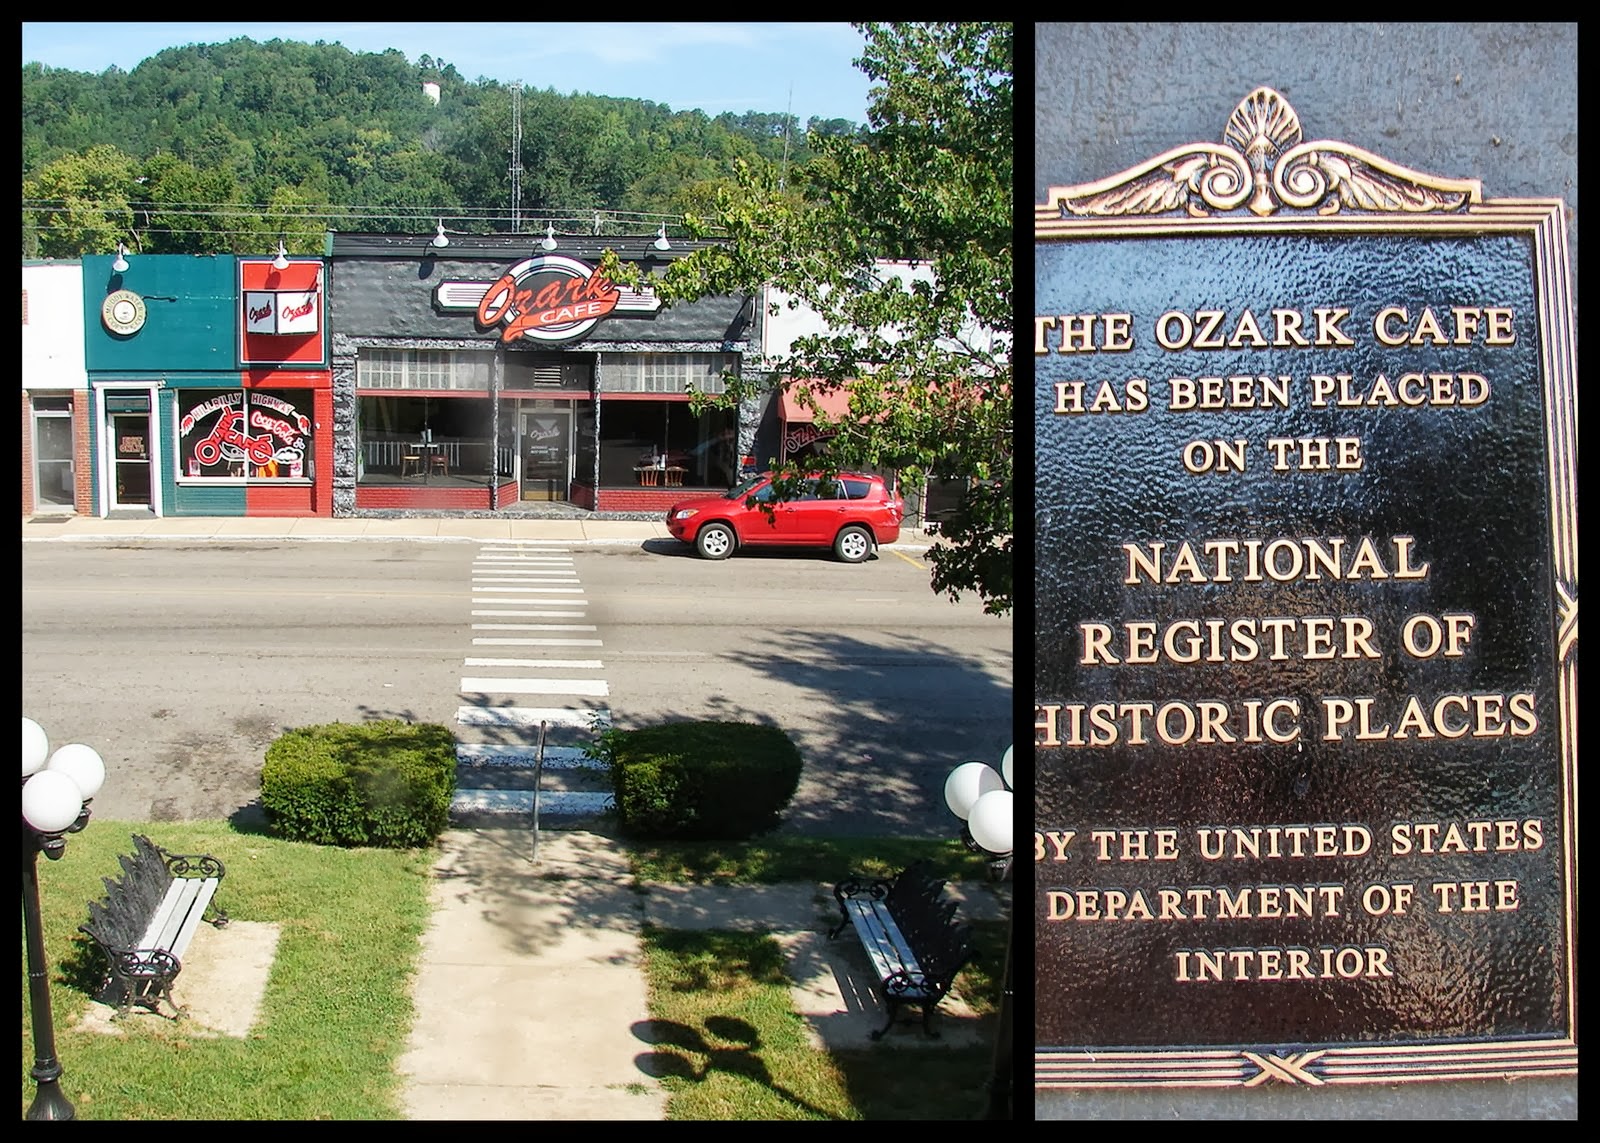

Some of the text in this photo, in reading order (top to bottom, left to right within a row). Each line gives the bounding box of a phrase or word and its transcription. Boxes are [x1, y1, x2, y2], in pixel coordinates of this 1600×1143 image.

[477, 266, 619, 342] Ozark
[540, 302, 601, 323] CAFE
[1034, 307, 1515, 353] THE OZARK CAFE
[190, 393, 295, 422] HILLBILLY HIGHWAY
[1054, 373, 1489, 413] HAS BEEN PLACED
[251, 411, 299, 446] Coca-Cola
[1183, 438, 1363, 472] ON THE
[1123, 537, 1428, 584] NATIONAL
[1080, 615, 1474, 664] REGISTER OF
[1034, 693, 1537, 746] HISTORIC PLACES
[1091, 830, 1179, 861] THE
[1197, 826, 1371, 860] UNITED
[1391, 819, 1543, 855] STATES
[1046, 880, 1520, 921] DEPARTMENT OF THE
[1175, 948, 1393, 982] INTERIOR
